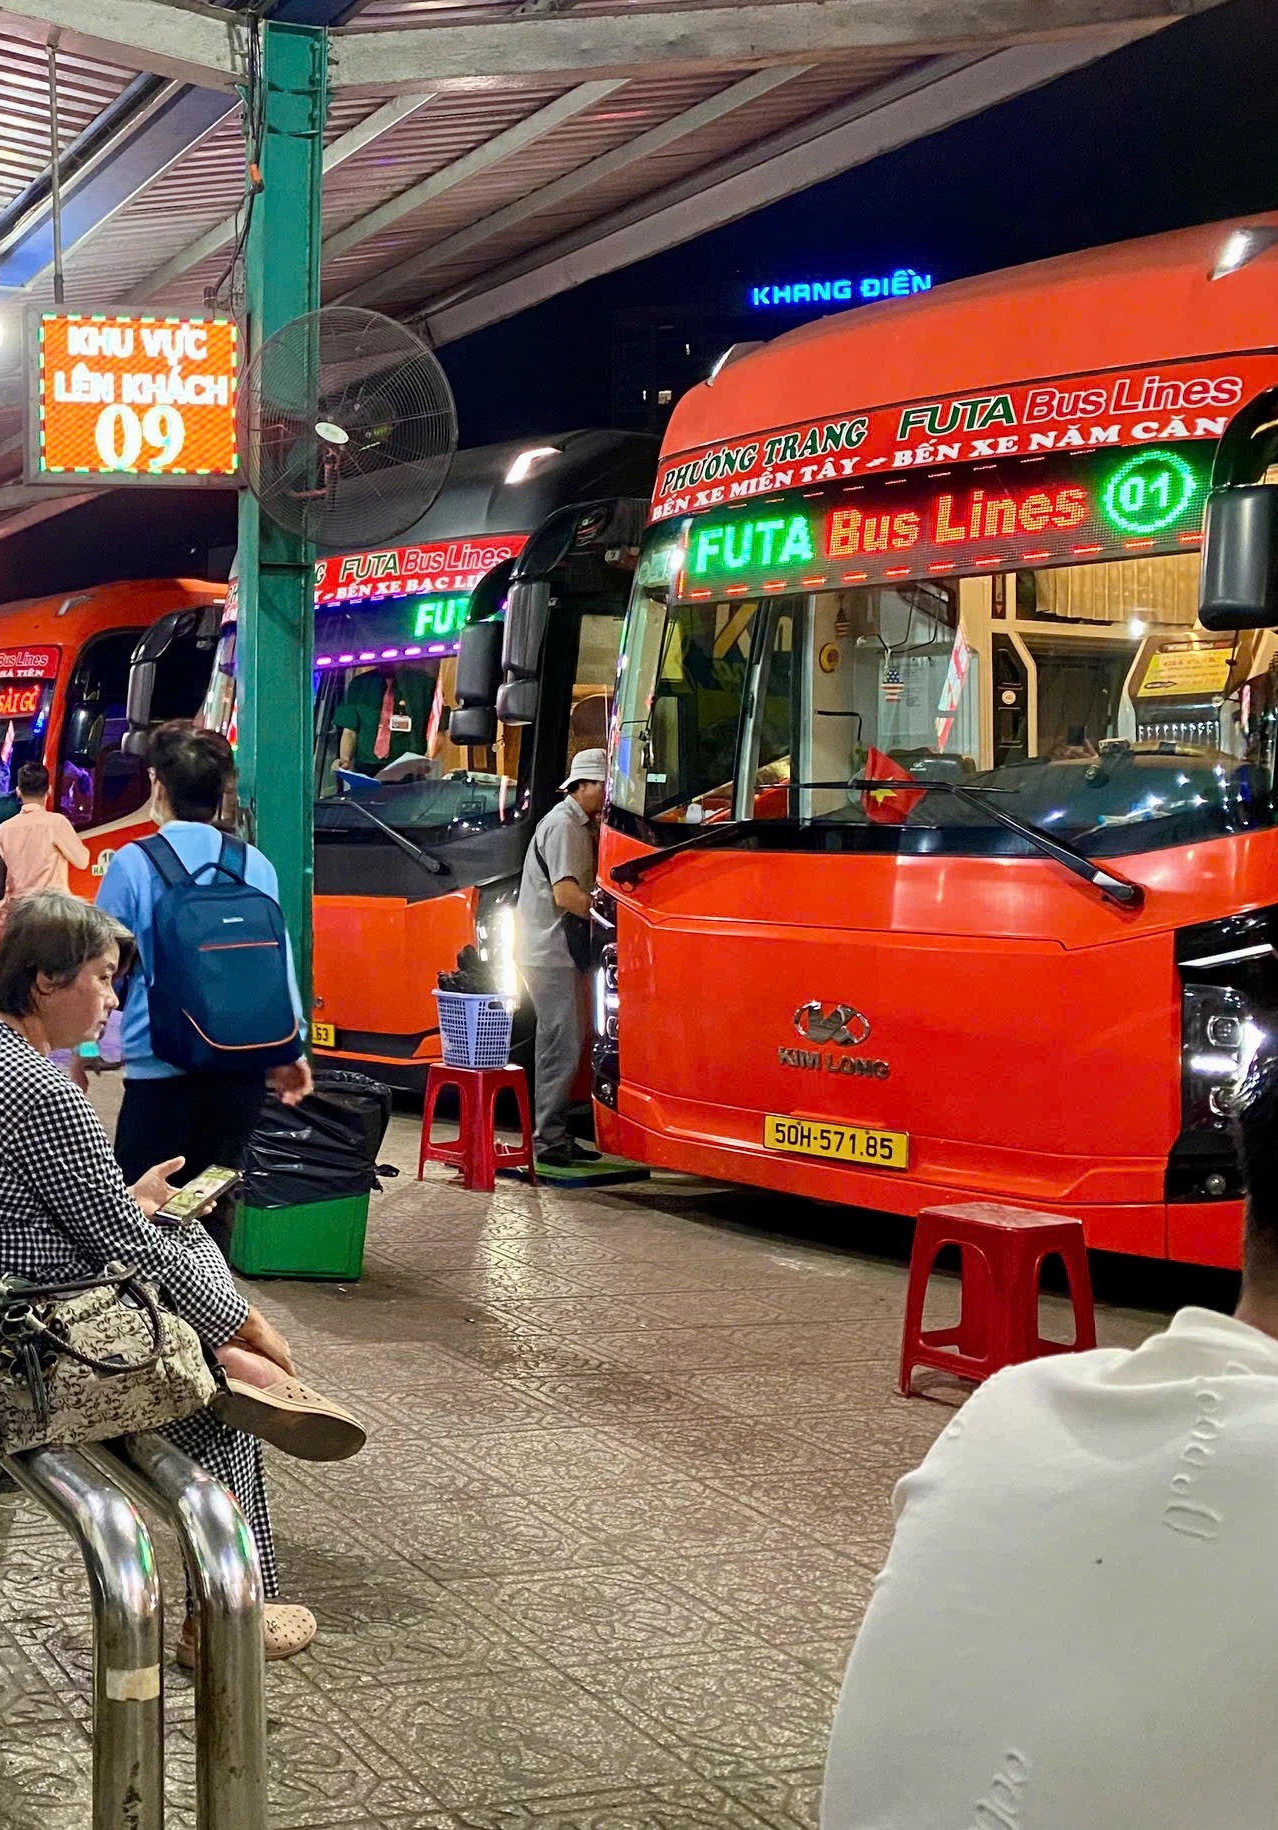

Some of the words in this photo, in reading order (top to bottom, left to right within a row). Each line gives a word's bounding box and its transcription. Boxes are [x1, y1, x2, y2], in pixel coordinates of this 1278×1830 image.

[754, 280, 852, 305] KHANG
[860, 269, 932, 297] ĐIỀN
[68, 326, 133, 358] KHU
[140, 323, 207, 366] VỰC
[54, 362, 114, 403] LÊN
[122, 366, 228, 405] KHÁCH
[95, 404, 186, 469] 09
[660, 443, 759, 497] PHƯƠNG
[764, 418, 868, 465] TRANG
[897, 394, 1019, 441] FUTA
[1023, 388, 1105, 424] Bus
[1111, 375, 1243, 414] Lines
[651, 494, 690, 521] BẾN
[693, 485, 725, 507] XE
[729, 467, 795, 499] MIỀN
[800, 457, 861, 483] TÂY
[891, 439, 960, 467] BẾN
[972, 435, 1019, 458] XE
[1027, 423, 1121, 451] NĂM
[1131, 416, 1230, 438] CĂN
[695, 514, 814, 573] FUTA
[828, 508, 920, 556] Bus
[934, 487, 1087, 544] Lines
[1121, 471, 1170, 512] 01
[339, 553, 399, 582] FUTA
[401, 549, 444, 574] Bus
[445, 544, 511, 571] Lines
[335, 580, 371, 599] BẾN
[375, 580, 401, 594] XE
[406, 575, 449, 592] BẠC
[16, 651, 49, 667] Lines
[778, 1047, 820, 1070] KIM
[826, 1054, 890, 1079] LONG
[775, 1123, 893, 1160] 50H-571.85
